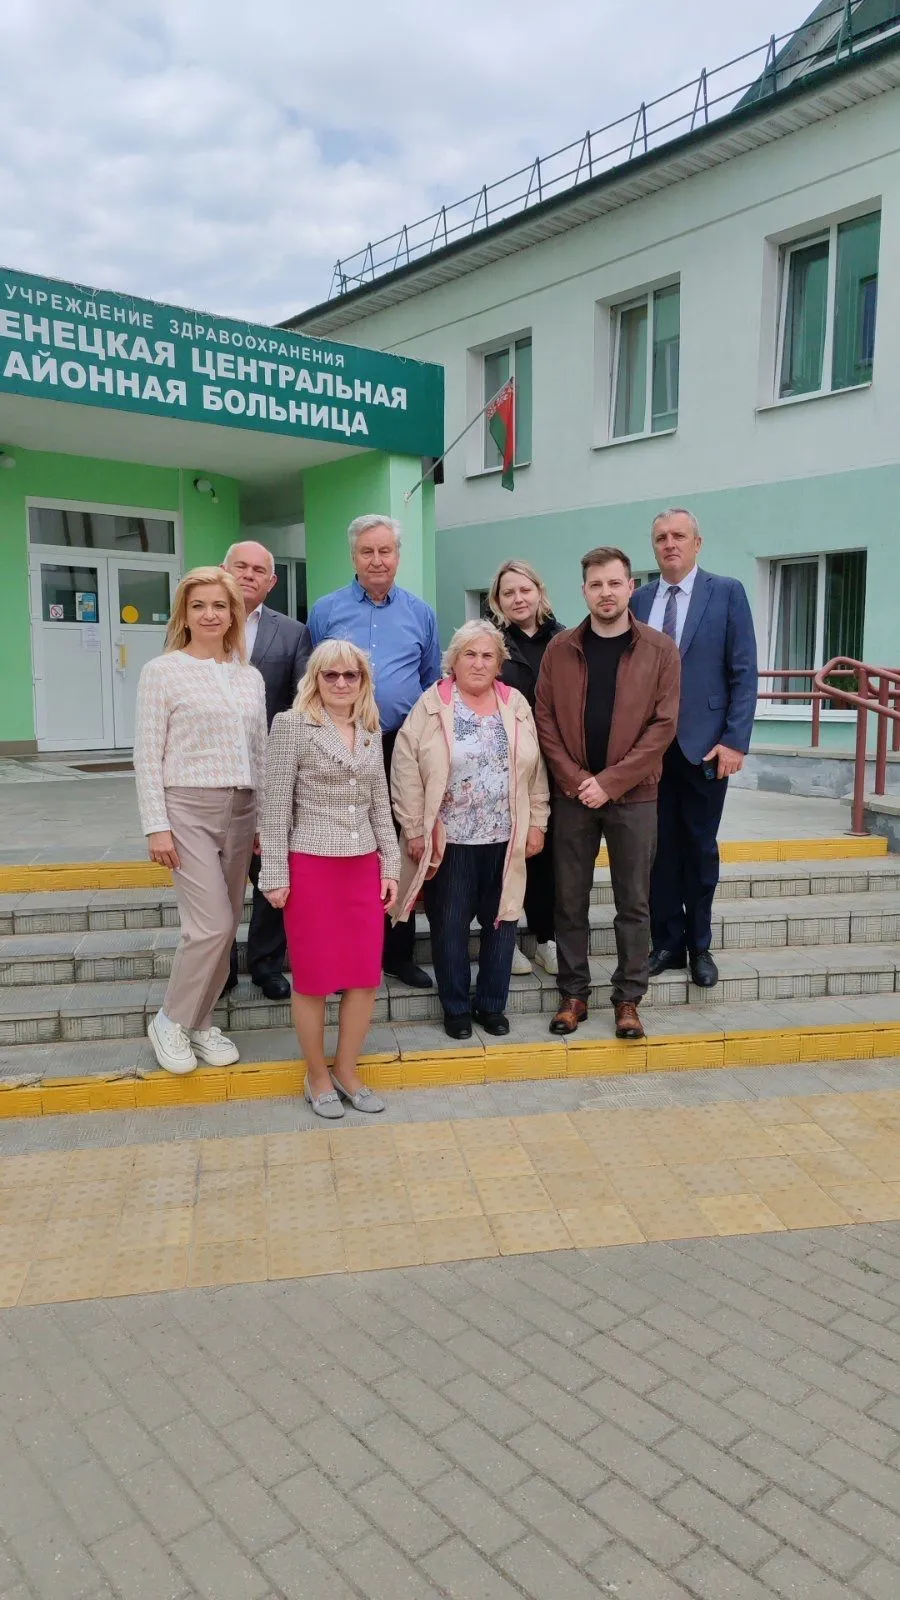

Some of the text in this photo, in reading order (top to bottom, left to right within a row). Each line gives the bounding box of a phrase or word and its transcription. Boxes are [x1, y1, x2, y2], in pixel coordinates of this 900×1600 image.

[0, 309, 407, 410] ЕНЕЦКАЯ ЦЕНТРАЛЬНАЯ
[5, 283, 345, 368] УЧРЕЖДЕНИЕ ЗДРАВООХРАНЕНИЯ
[3, 350, 369, 437] АЙОННАЯ БОЛЬНИЦА
